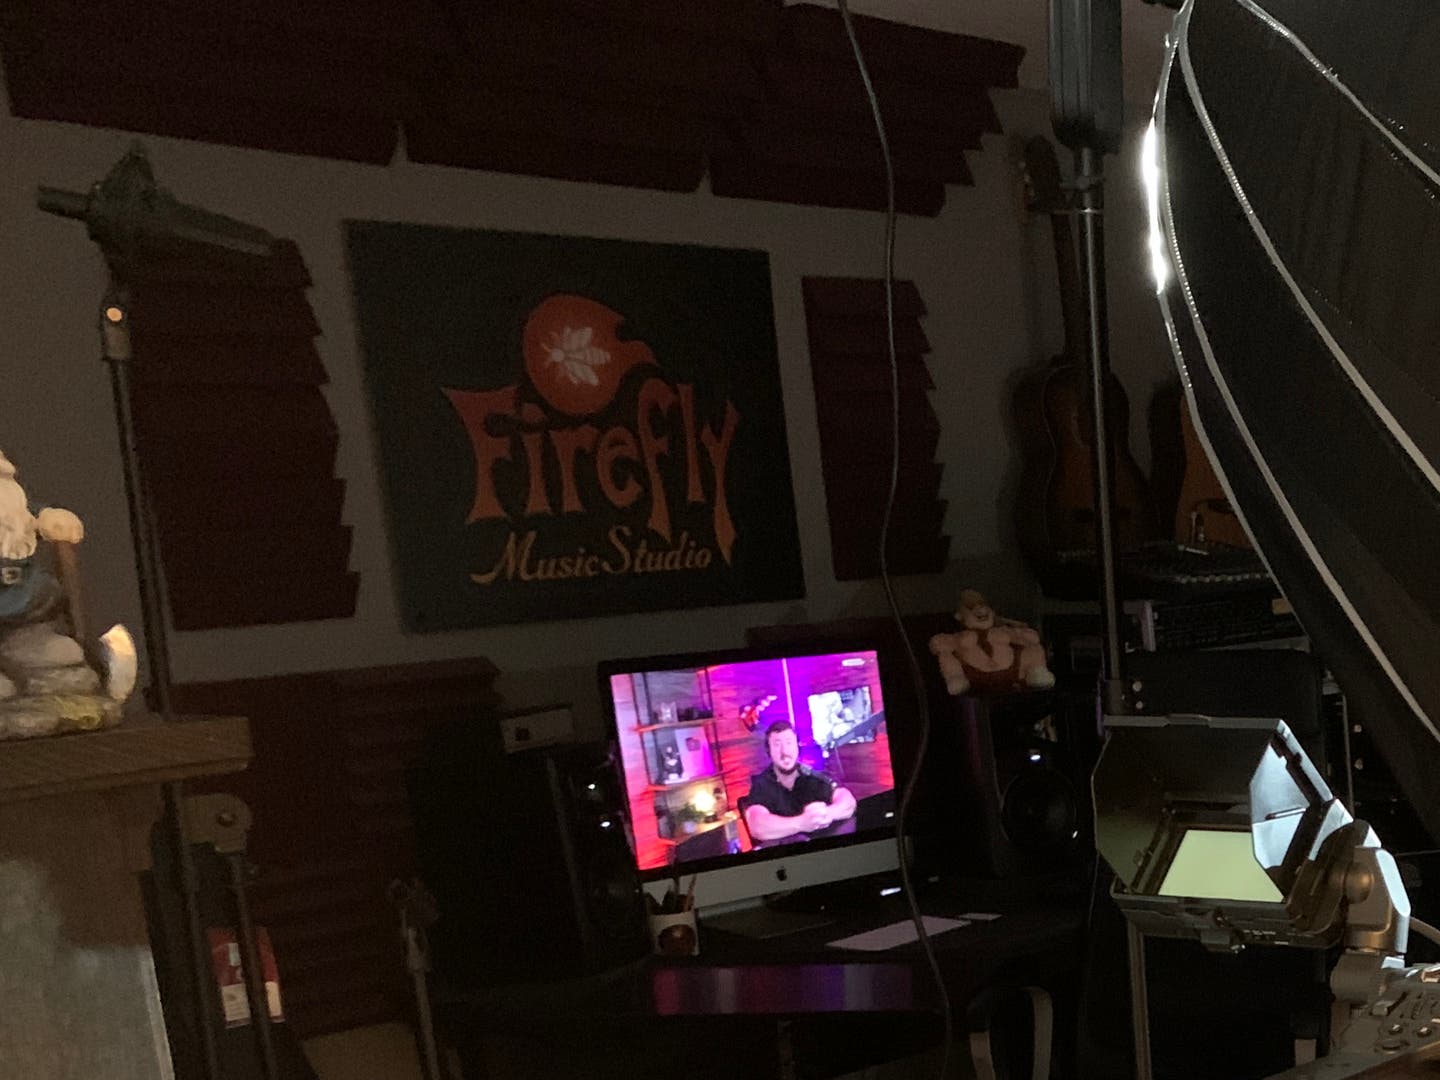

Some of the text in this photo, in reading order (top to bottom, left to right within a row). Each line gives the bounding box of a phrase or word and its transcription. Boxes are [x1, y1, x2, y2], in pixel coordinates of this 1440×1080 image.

[440, 377, 742, 568] Firefly
[469, 525, 713, 586] Music Studio
